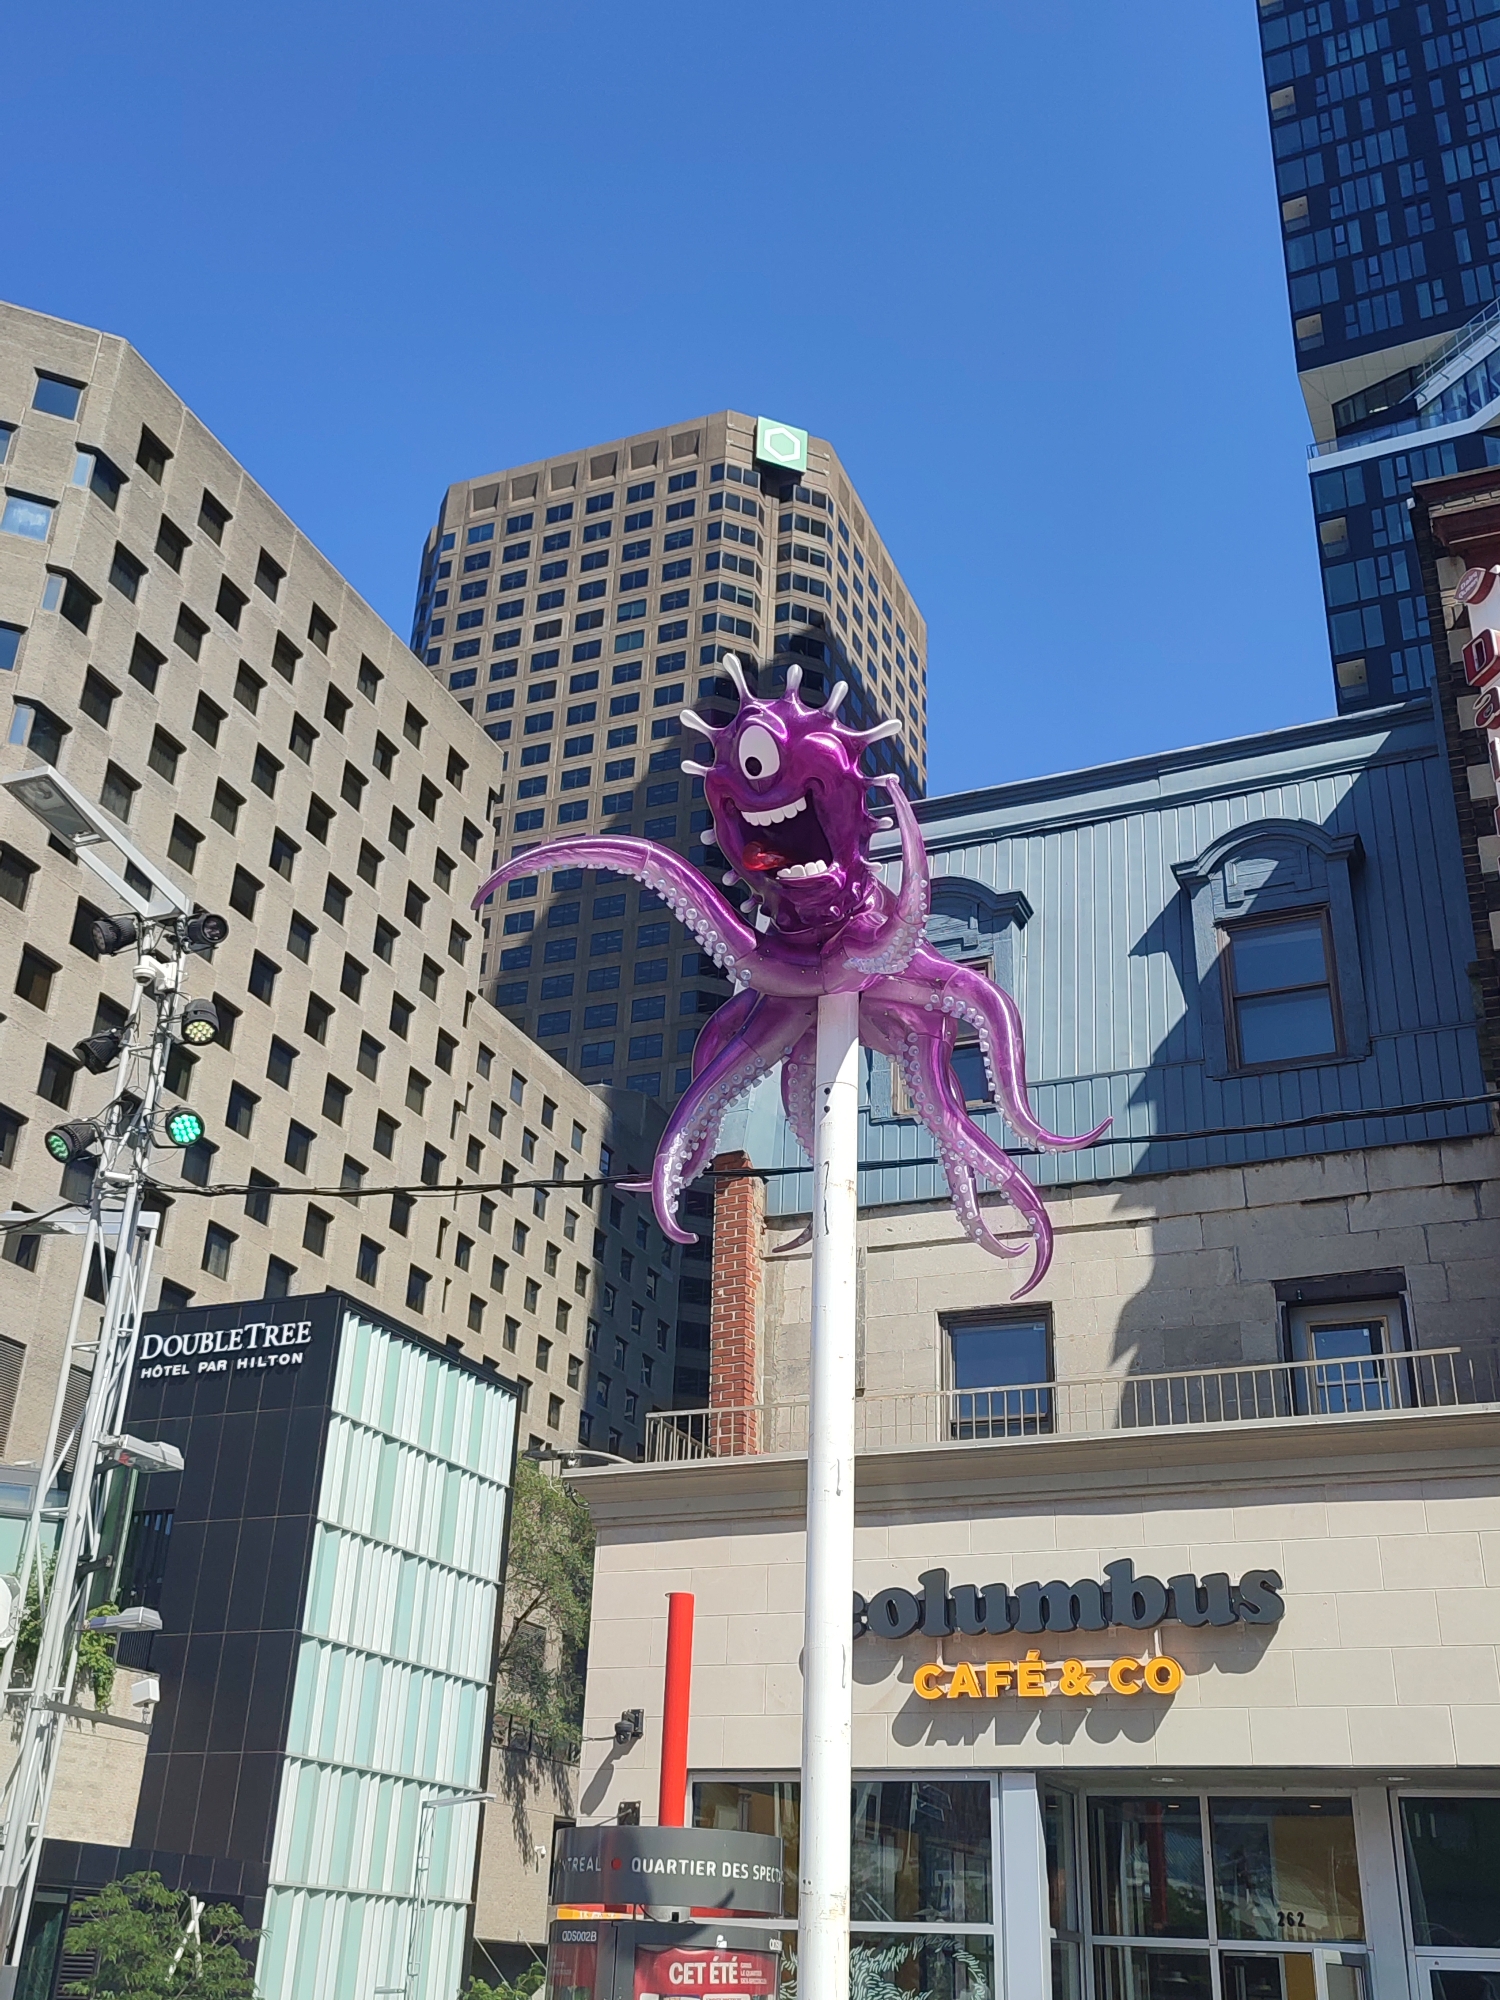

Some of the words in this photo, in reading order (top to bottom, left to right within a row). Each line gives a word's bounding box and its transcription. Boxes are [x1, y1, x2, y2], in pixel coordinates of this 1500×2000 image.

[140, 1364, 190, 1379] HÔTEL
[197, 1360, 228, 1374] PAR
[236, 1352, 303, 1370] HILTON
[913, 1649, 1048, 1700] CAFÉ
[1058, 1658, 1098, 1697] &
[1107, 1655, 1184, 1696] CO
[631, 1856, 716, 1877] QUARTIER
[721, 1861, 749, 1880] DES
[1276, 1910, 1307, 1928] 262
[669, 1962, 706, 1985] CET
[709, 1955, 739, 1985] ÉTÉ
